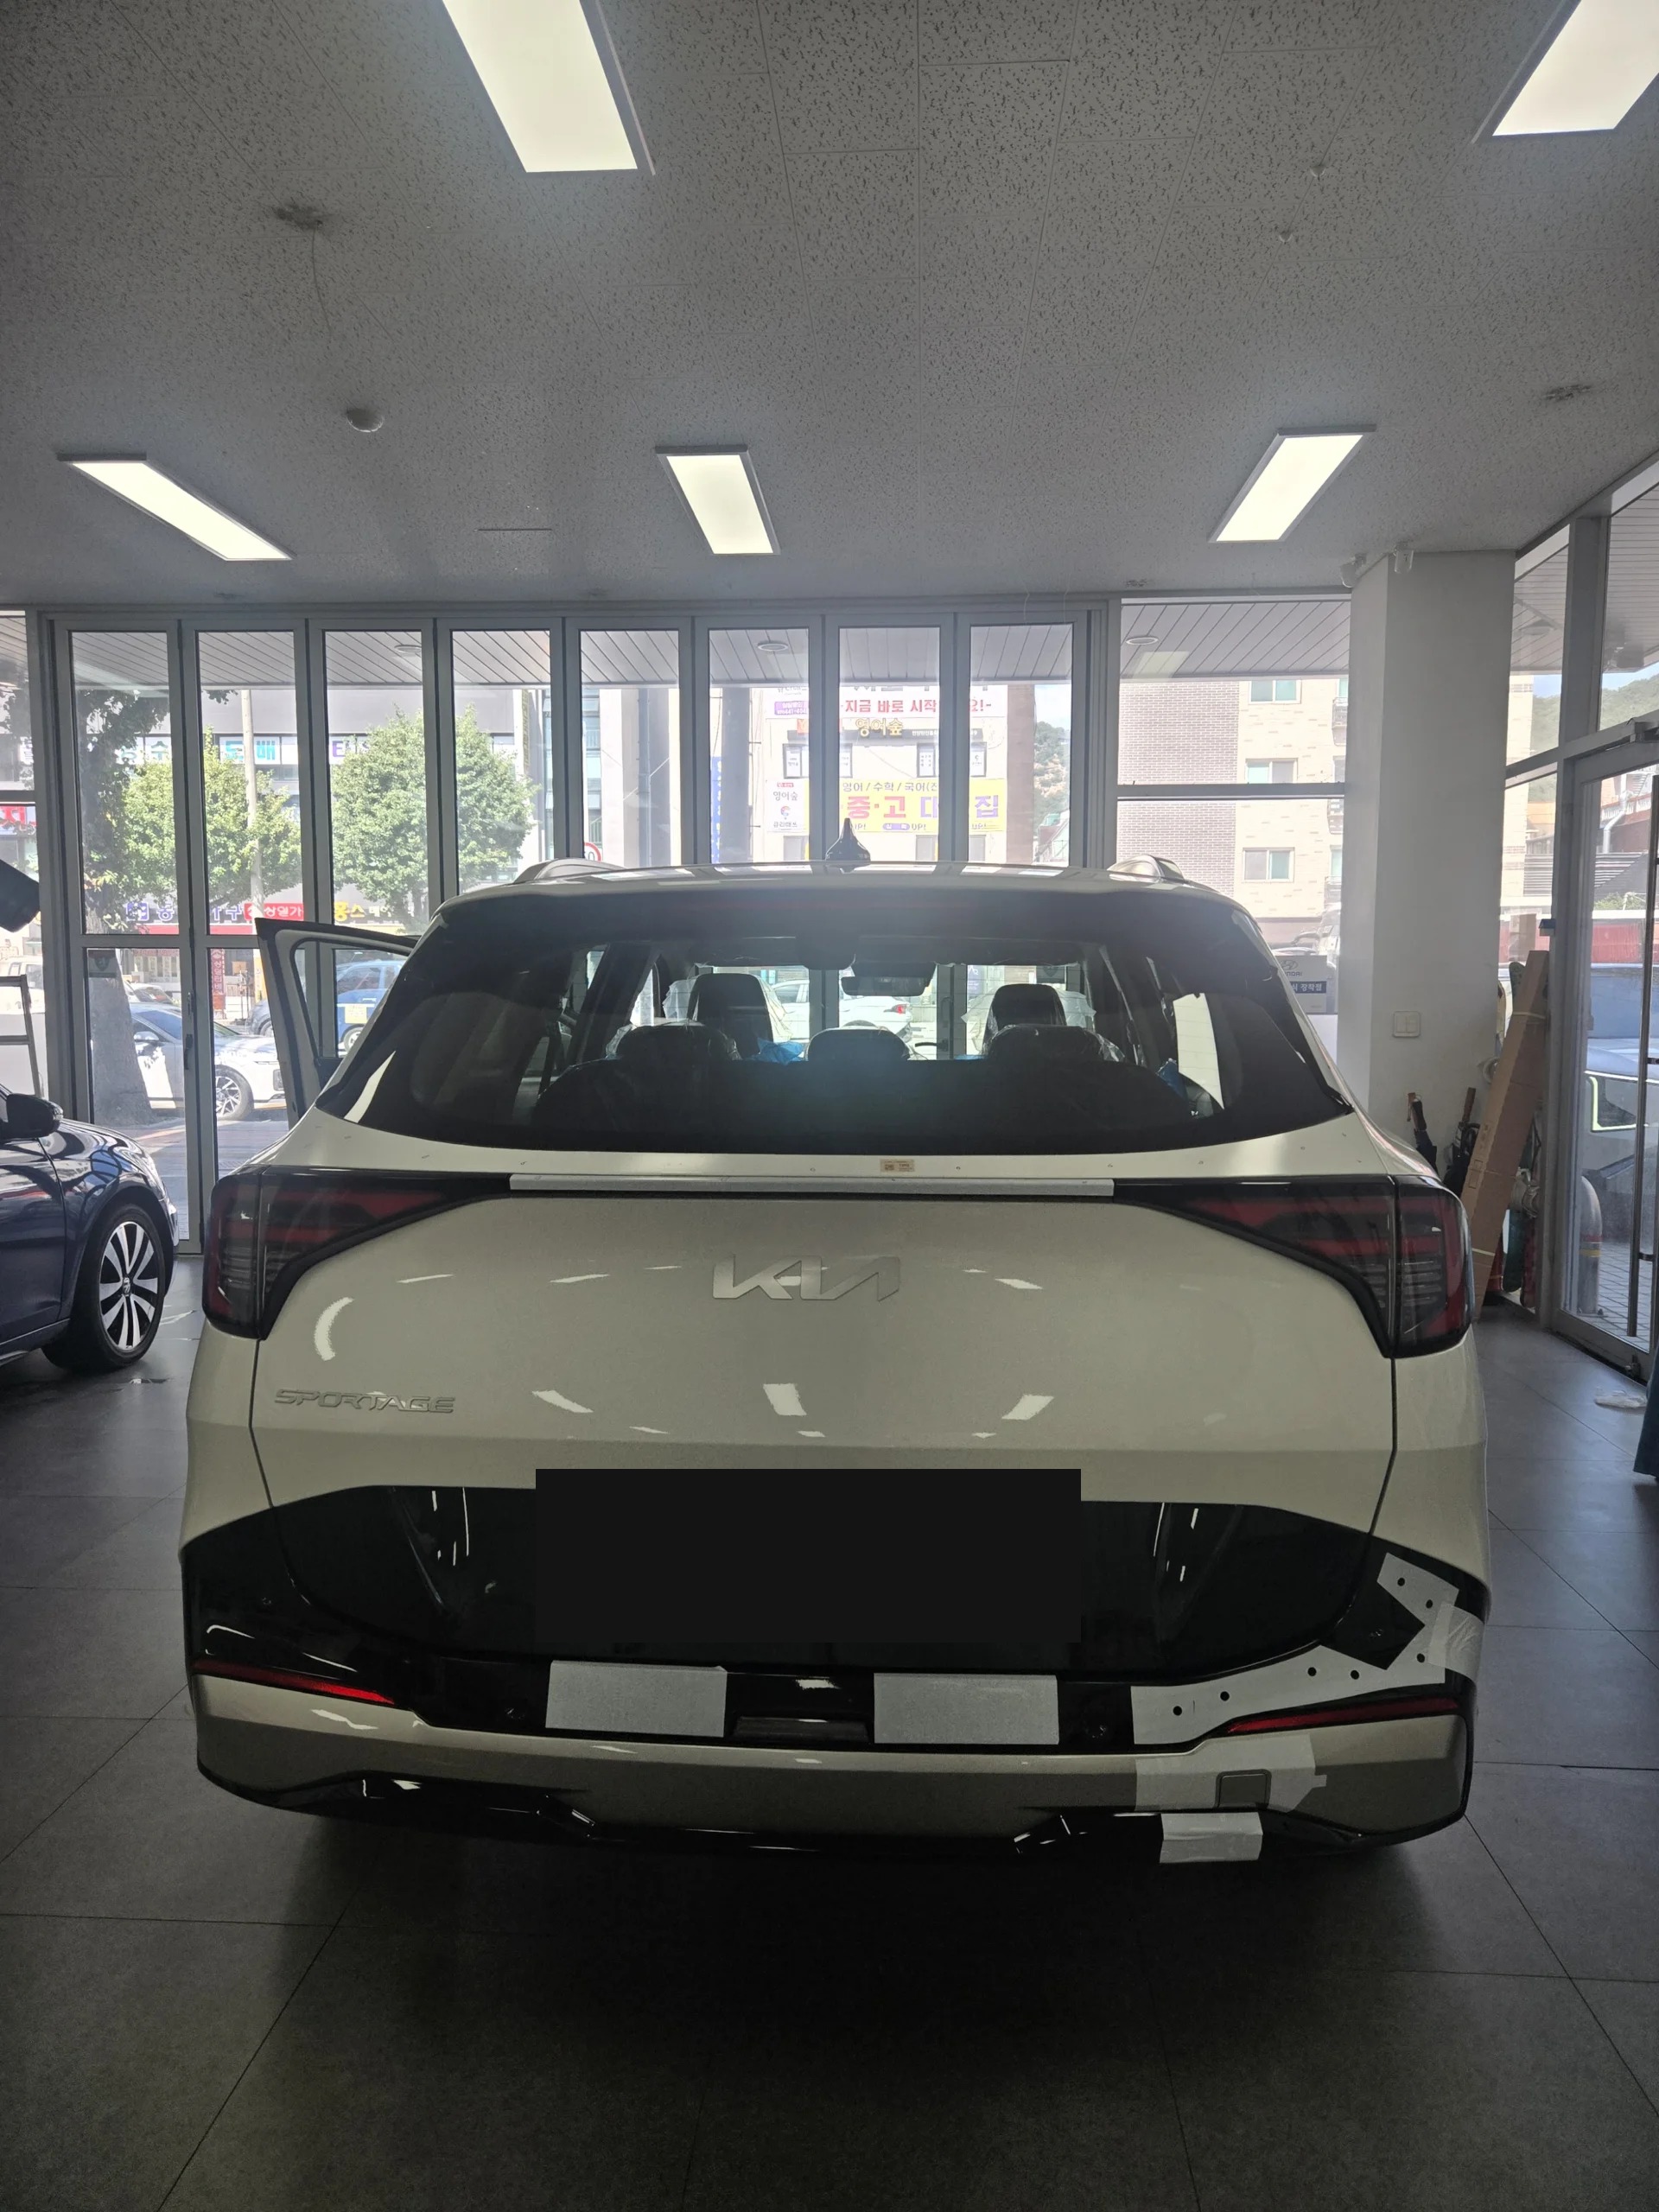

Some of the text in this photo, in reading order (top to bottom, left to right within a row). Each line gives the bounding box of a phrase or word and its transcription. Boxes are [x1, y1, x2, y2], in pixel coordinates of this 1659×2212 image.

[877, 700, 904, 713] 바로
[855, 717, 904, 739] 영어숲
[842, 781, 864, 792] 영어
[873, 781, 895, 792] 수학
[772, 791, 798, 802] 영어숲
[1300, 982, 1322, 992] 장착점
[713, 1254, 900, 1302] KIA
[275, 1389, 455, 1414] SPORTAGE
